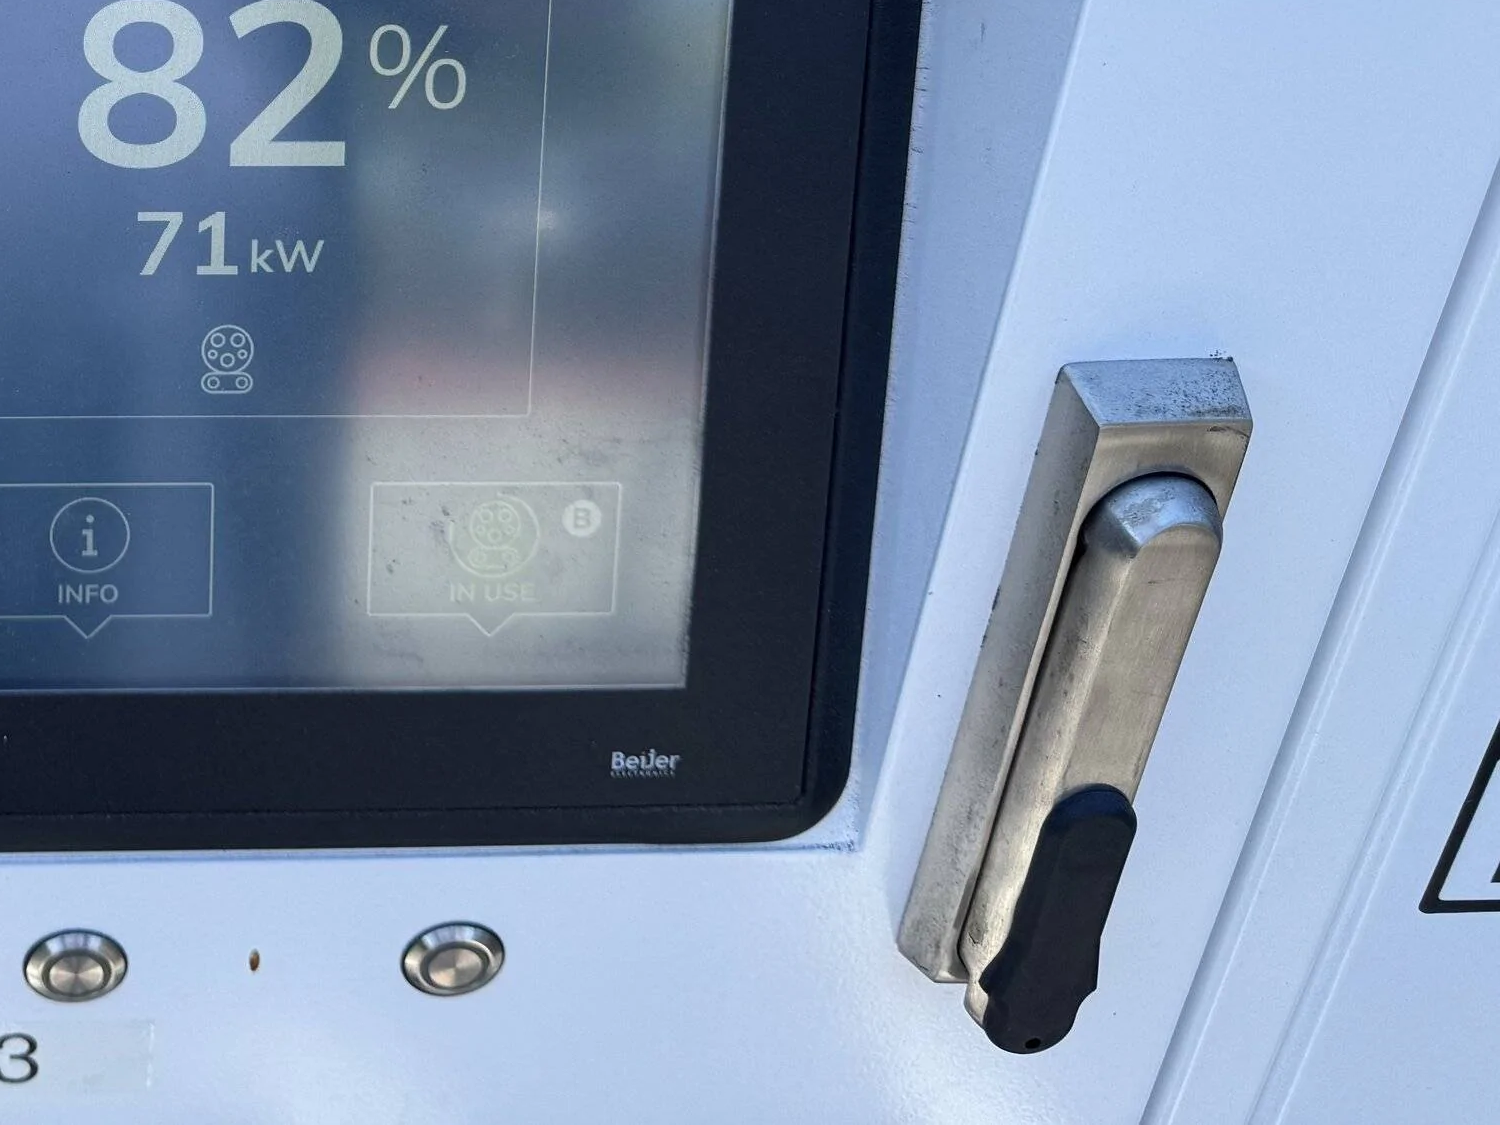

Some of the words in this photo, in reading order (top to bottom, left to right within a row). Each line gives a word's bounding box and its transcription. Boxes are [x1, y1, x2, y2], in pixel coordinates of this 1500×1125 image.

[58, 584, 118, 603] INFO
[450, 583, 475, 602] IN
[484, 583, 537, 602] USE
